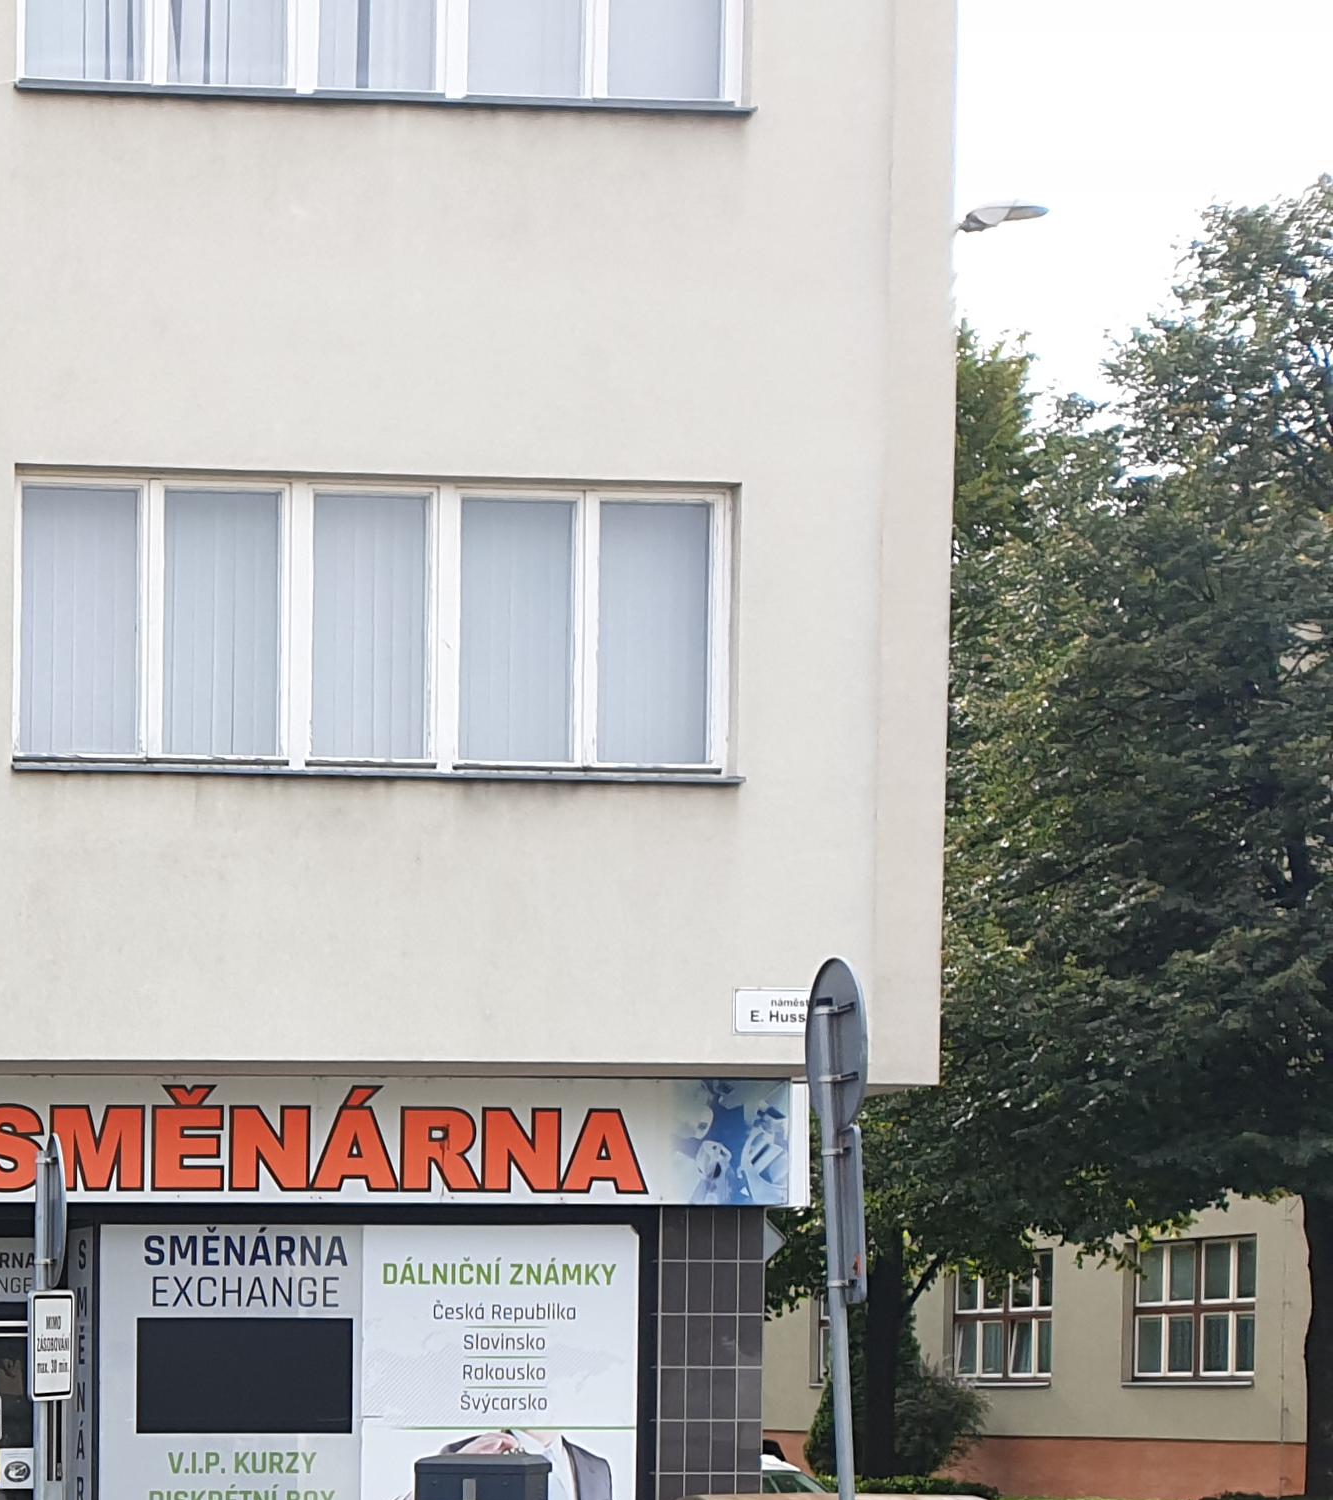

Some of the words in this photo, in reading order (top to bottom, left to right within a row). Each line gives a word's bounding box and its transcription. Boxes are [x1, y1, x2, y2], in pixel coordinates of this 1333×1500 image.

[771, 997, 810, 1008] náměst
[750, 1010, 764, 1022] E.
[769, 1010, 806, 1022] Huss
[144, 1227, 348, 1267] SMĚNÁRNA
[382, 1257, 501, 1286] DÁLNIČNÍ
[510, 1257, 617, 1287] ZNÁMKY
[152, 1276, 340, 1308] EXCHANGE
[433, 1300, 485, 1321] Česká
[491, 1303, 577, 1325] Republika
[463, 1333, 546, 1351] Slovinsko
[462, 1364, 546, 1382] Rakousko
[460, 1391, 548, 1415] Švýcarsko
[168, 1452, 226, 1474] V.I.P.
[234, 1452, 317, 1474] KURZY
